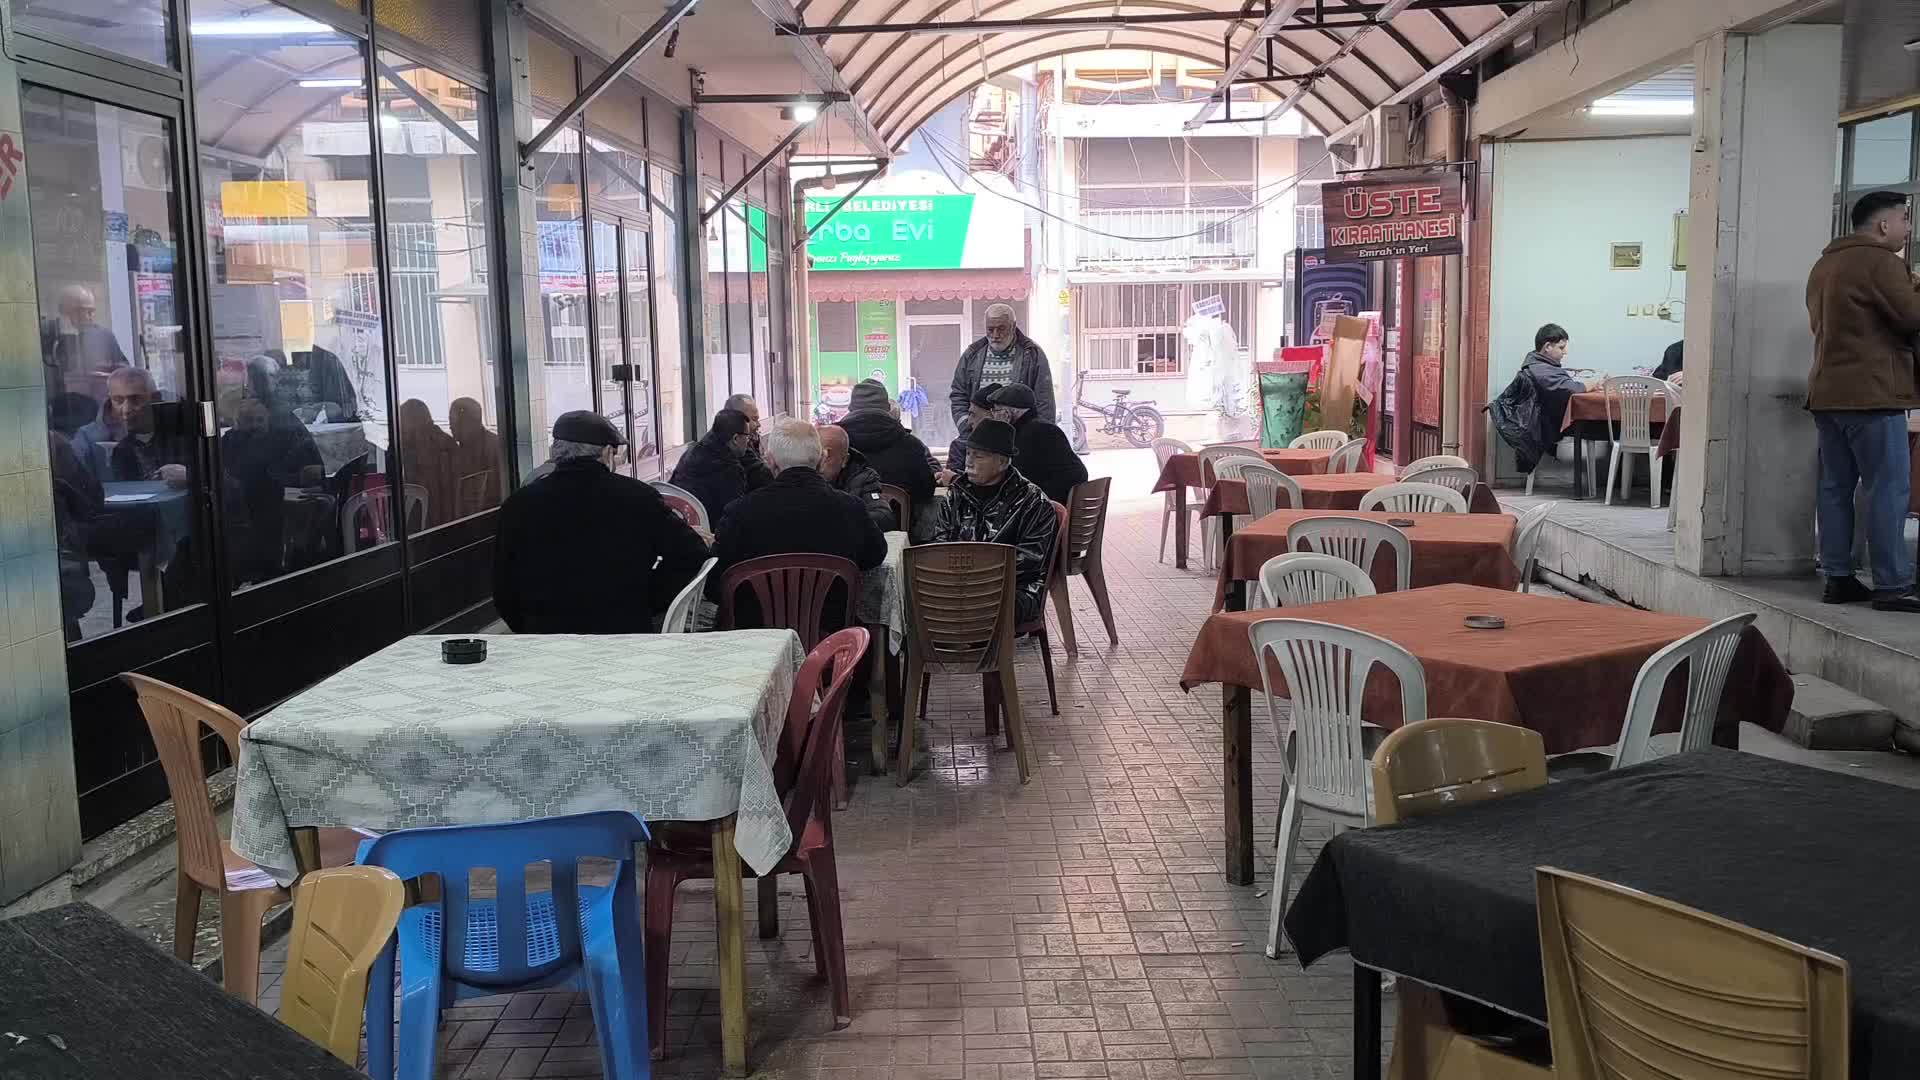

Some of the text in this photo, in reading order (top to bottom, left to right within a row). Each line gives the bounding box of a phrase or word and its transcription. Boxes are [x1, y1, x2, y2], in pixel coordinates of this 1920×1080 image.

[1344, 186, 1441, 219] ÜSTE
[892, 218, 935, 241] Evi
[1331, 213, 1456, 247] KIRAATHANESİ
[1407, 244, 1429, 255] Yeri
